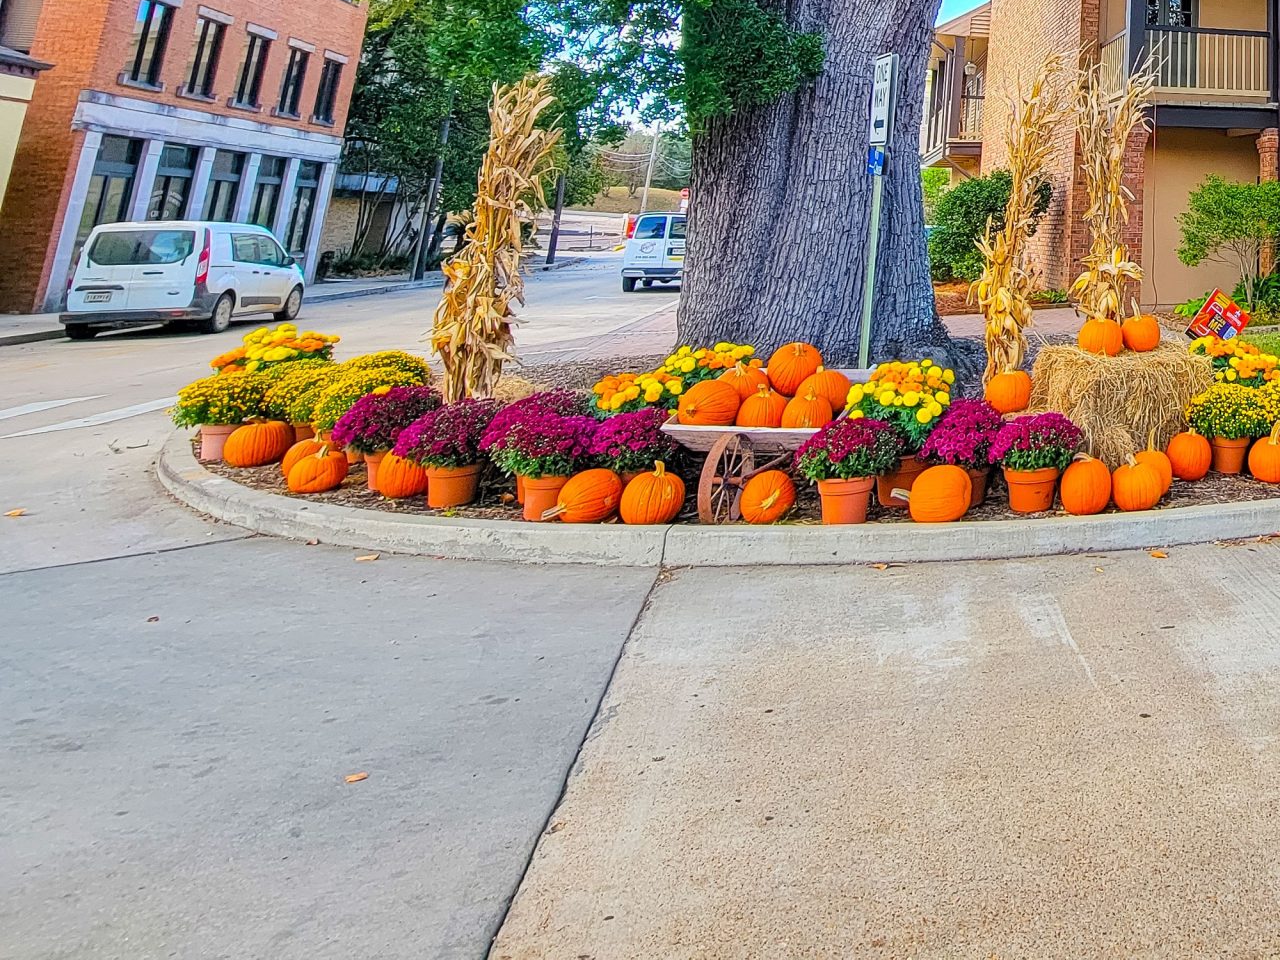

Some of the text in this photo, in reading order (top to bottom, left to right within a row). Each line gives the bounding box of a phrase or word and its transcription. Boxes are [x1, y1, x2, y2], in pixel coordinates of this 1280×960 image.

[876, 62, 889, 84] ONE
[874, 86, 888, 108] WAY
[1207, 318, 1221, 334] ME
